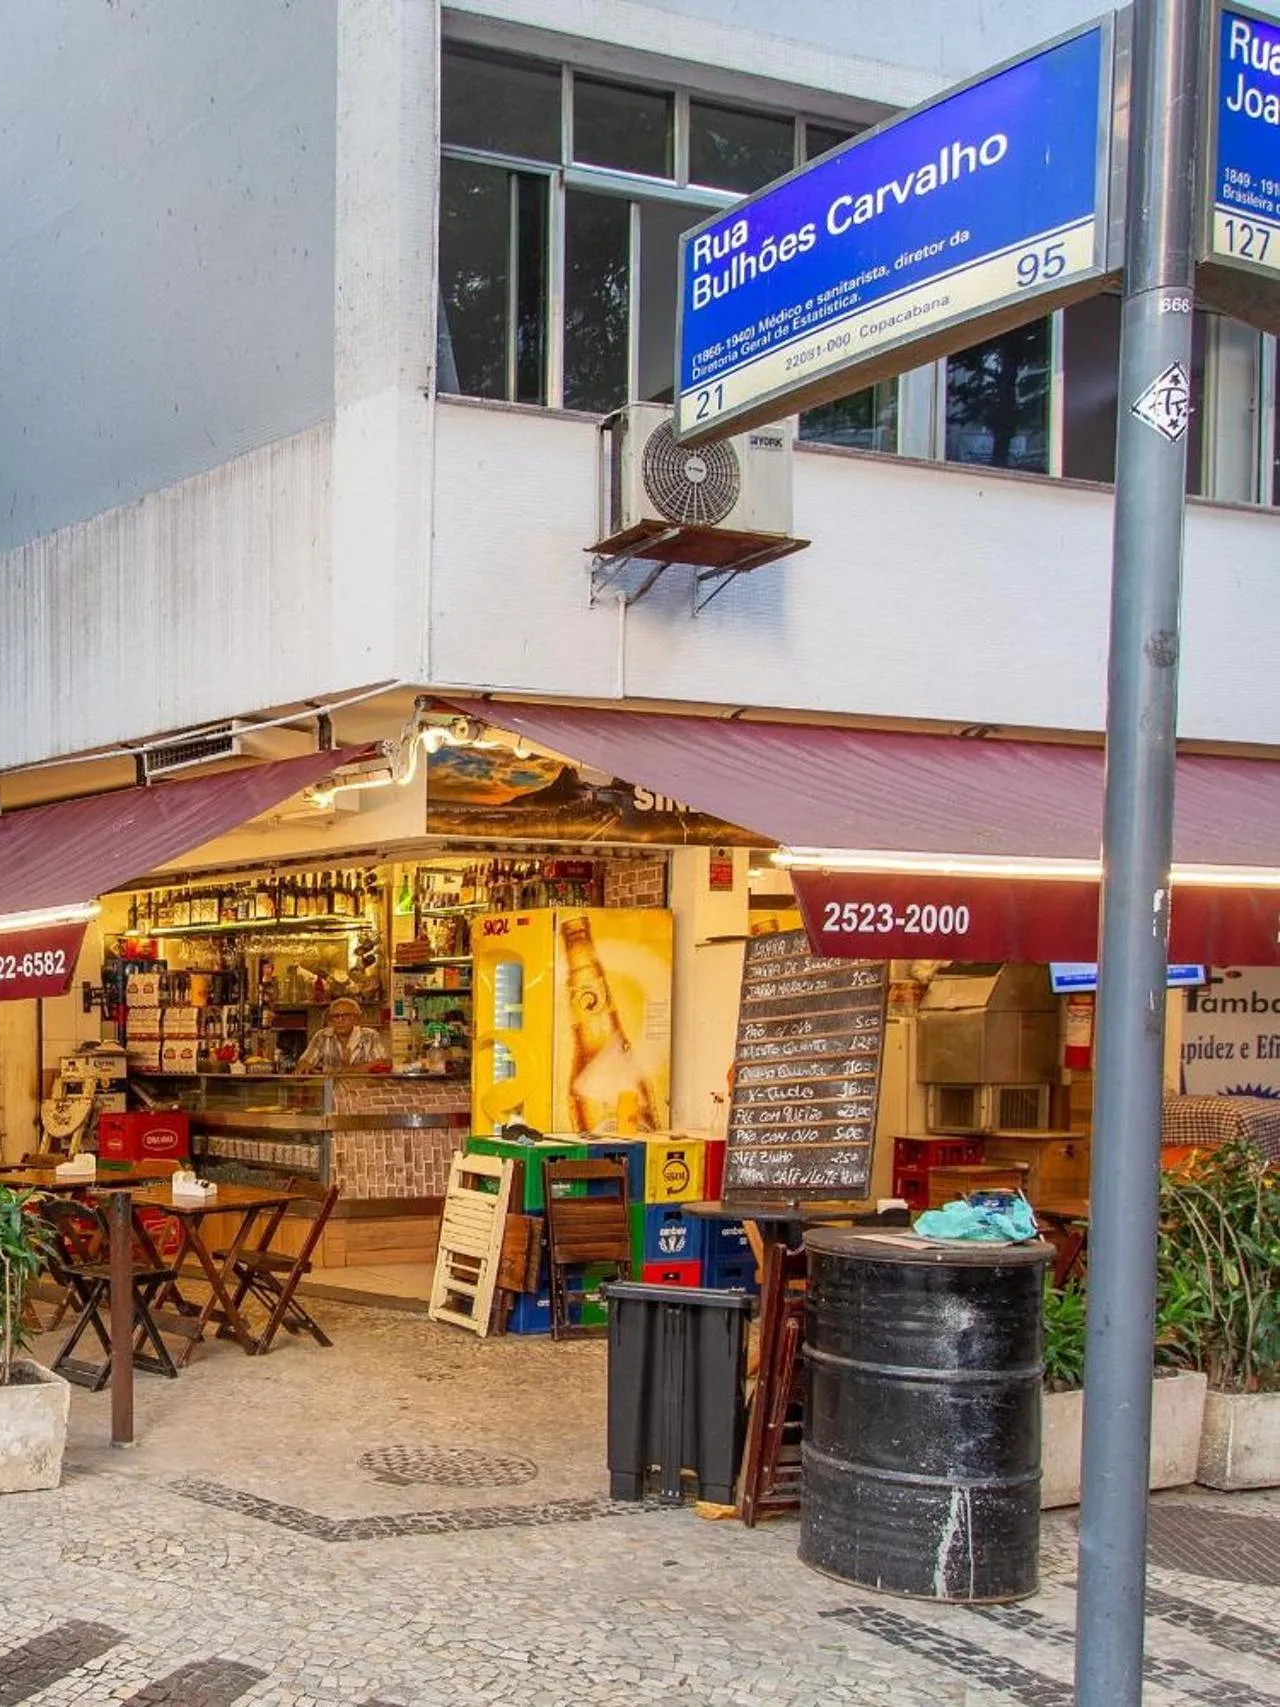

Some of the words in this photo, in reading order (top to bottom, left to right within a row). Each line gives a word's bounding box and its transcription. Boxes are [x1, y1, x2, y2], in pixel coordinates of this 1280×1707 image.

[1229, 20, 1280, 76] Rua
[1222, 183, 1274, 213] Brasileira
[1224, 166, 1252, 189] 1849
[692, 221, 817, 311] Bulhões
[826, 133, 1009, 236] Carvalho
[1225, 219, 1271, 261] 127
[693, 220, 749, 272] Rua
[1016, 242, 1066, 288] 95
[758, 304, 803, 334] Médico
[805, 299, 813, 311] e
[815, 265, 891, 306] sanitarista,
[894, 239, 946, 271] diretor
[949, 228, 971, 248] da
[859, 295, 951, 338] Copacabana
[692, 345, 739, 380] Diretoria
[740, 331, 772, 356] Geral
[774, 323, 790, 340] de
[695, 383, 725, 420] 21
[823, 902, 970, 935] 2523-2000
[1239, 1041, 1250, 1059] e
